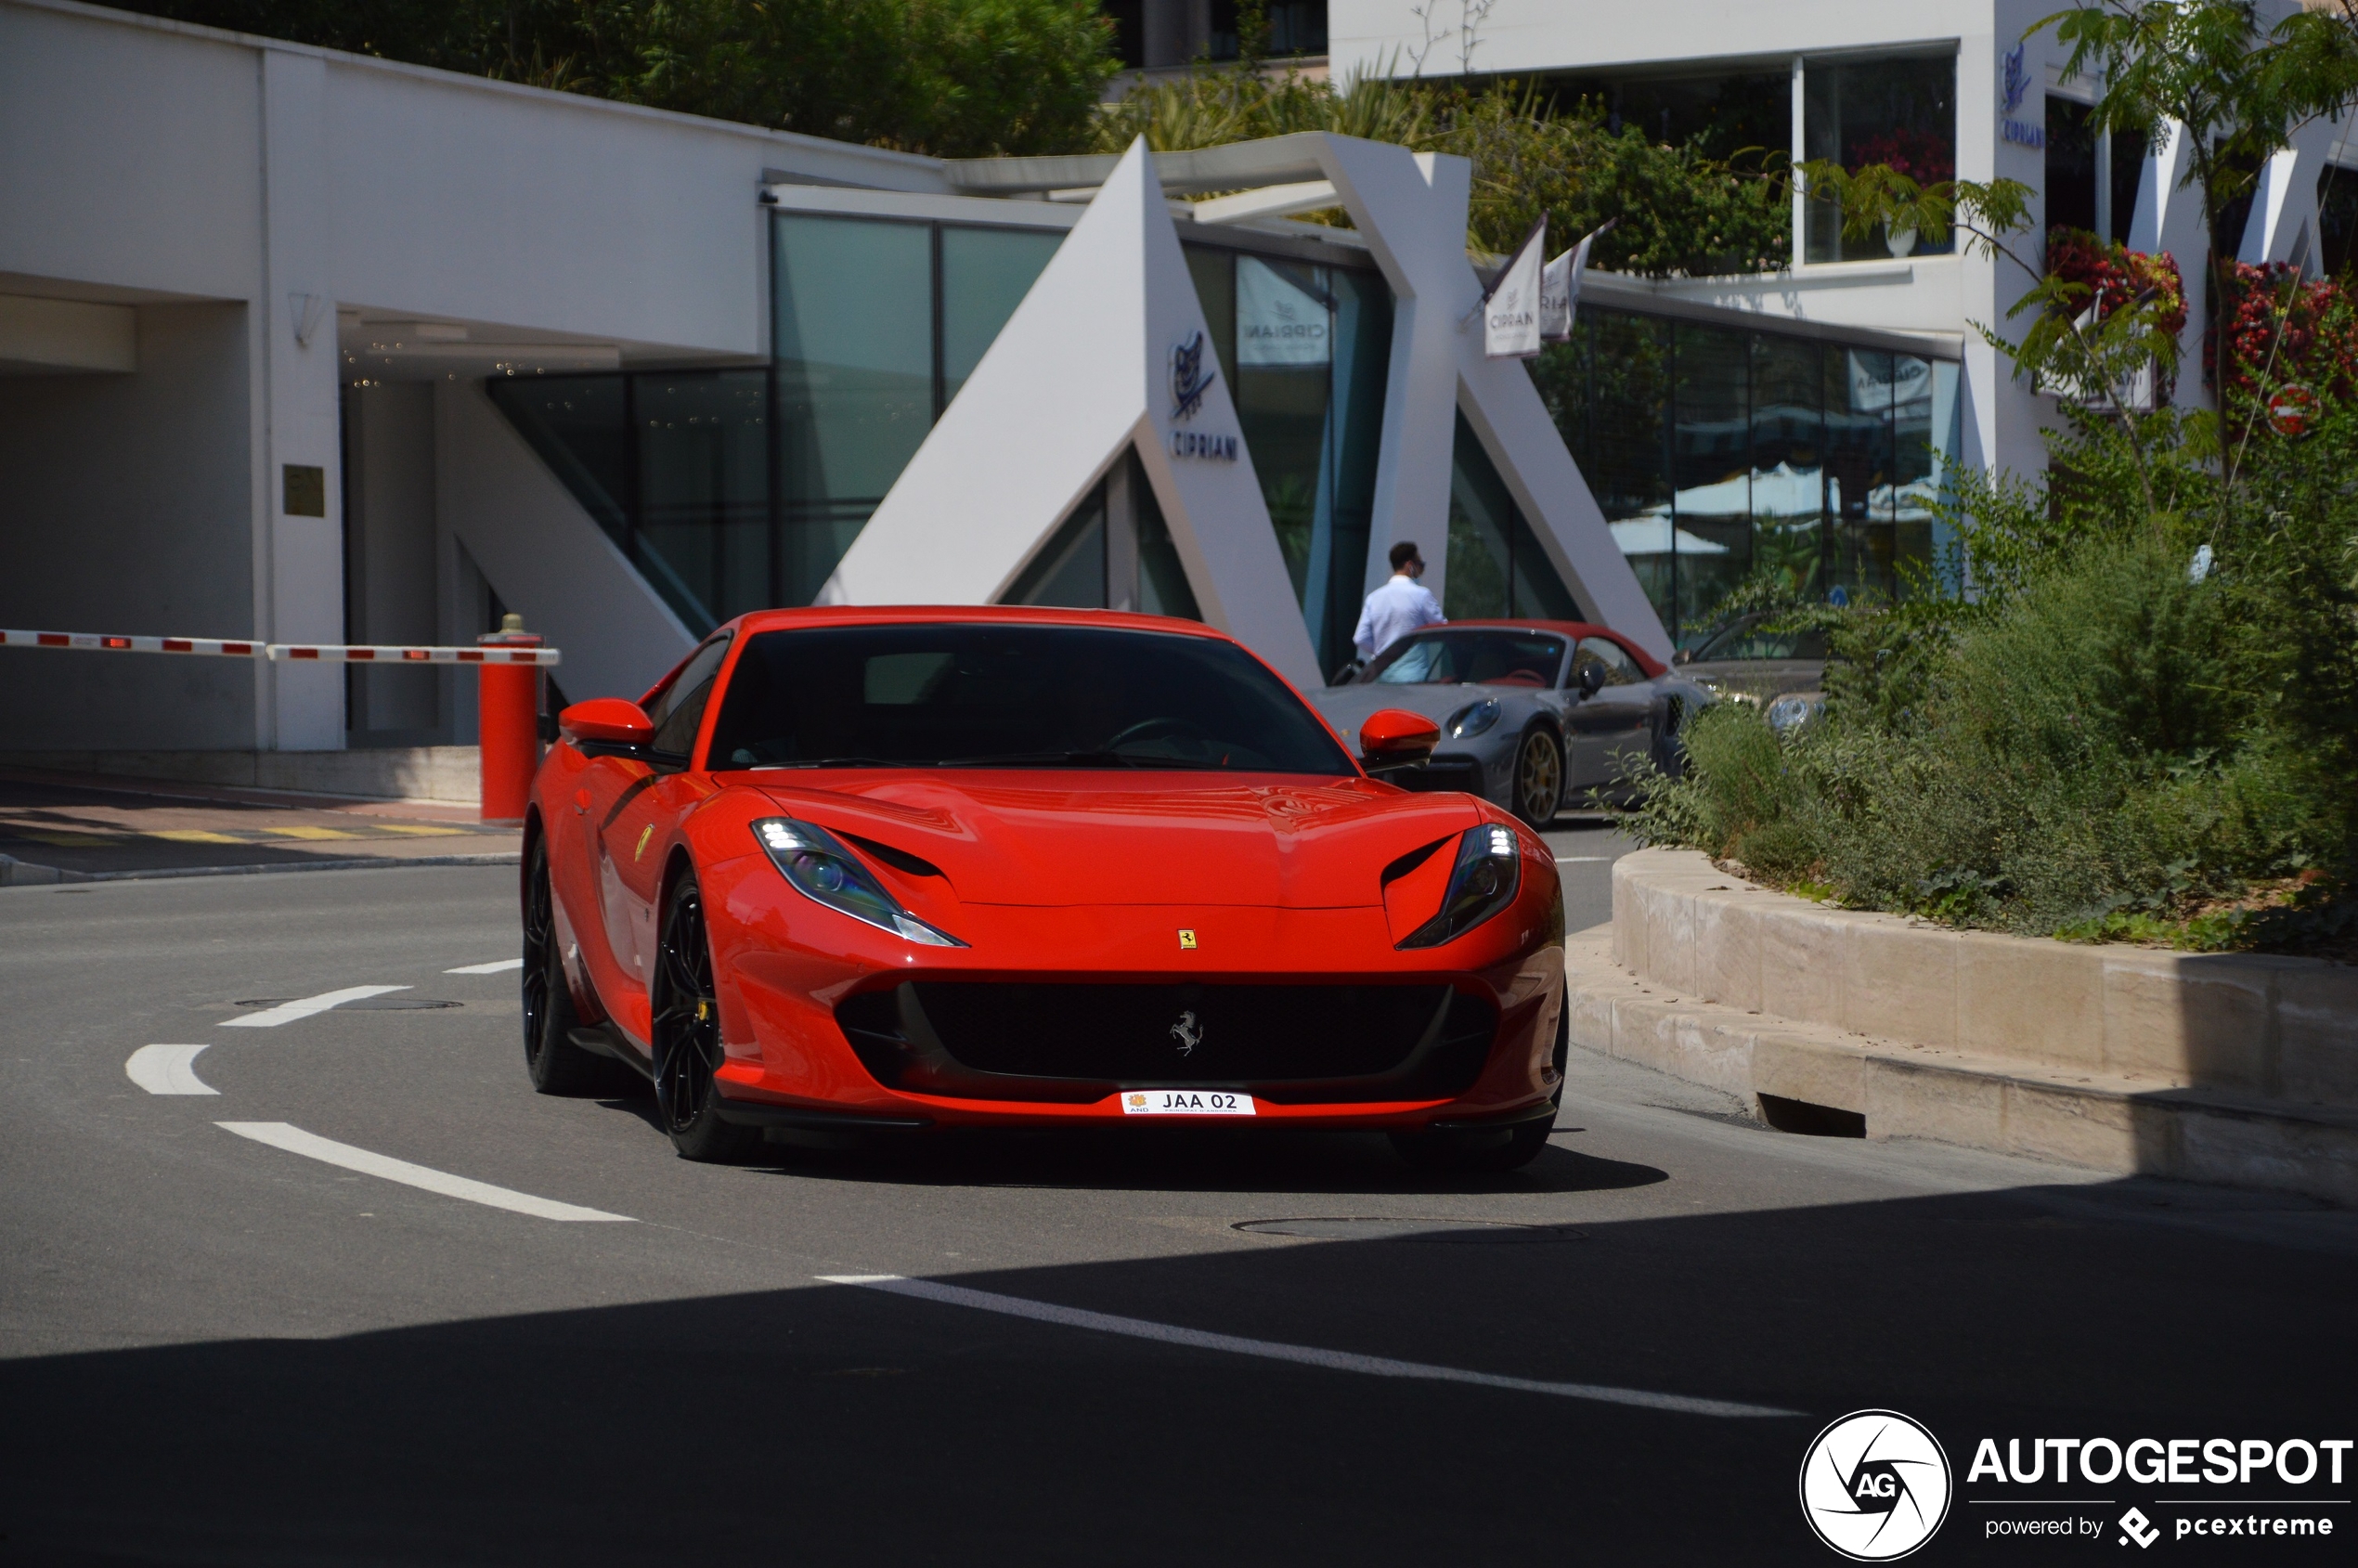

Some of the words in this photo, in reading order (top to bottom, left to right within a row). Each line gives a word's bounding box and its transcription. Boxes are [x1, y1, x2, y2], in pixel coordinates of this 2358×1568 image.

[1173, 430, 1237, 461] CIPRIANI
[1163, 1094, 1205, 1108] JAA
[1211, 1094, 1237, 1109] 02
